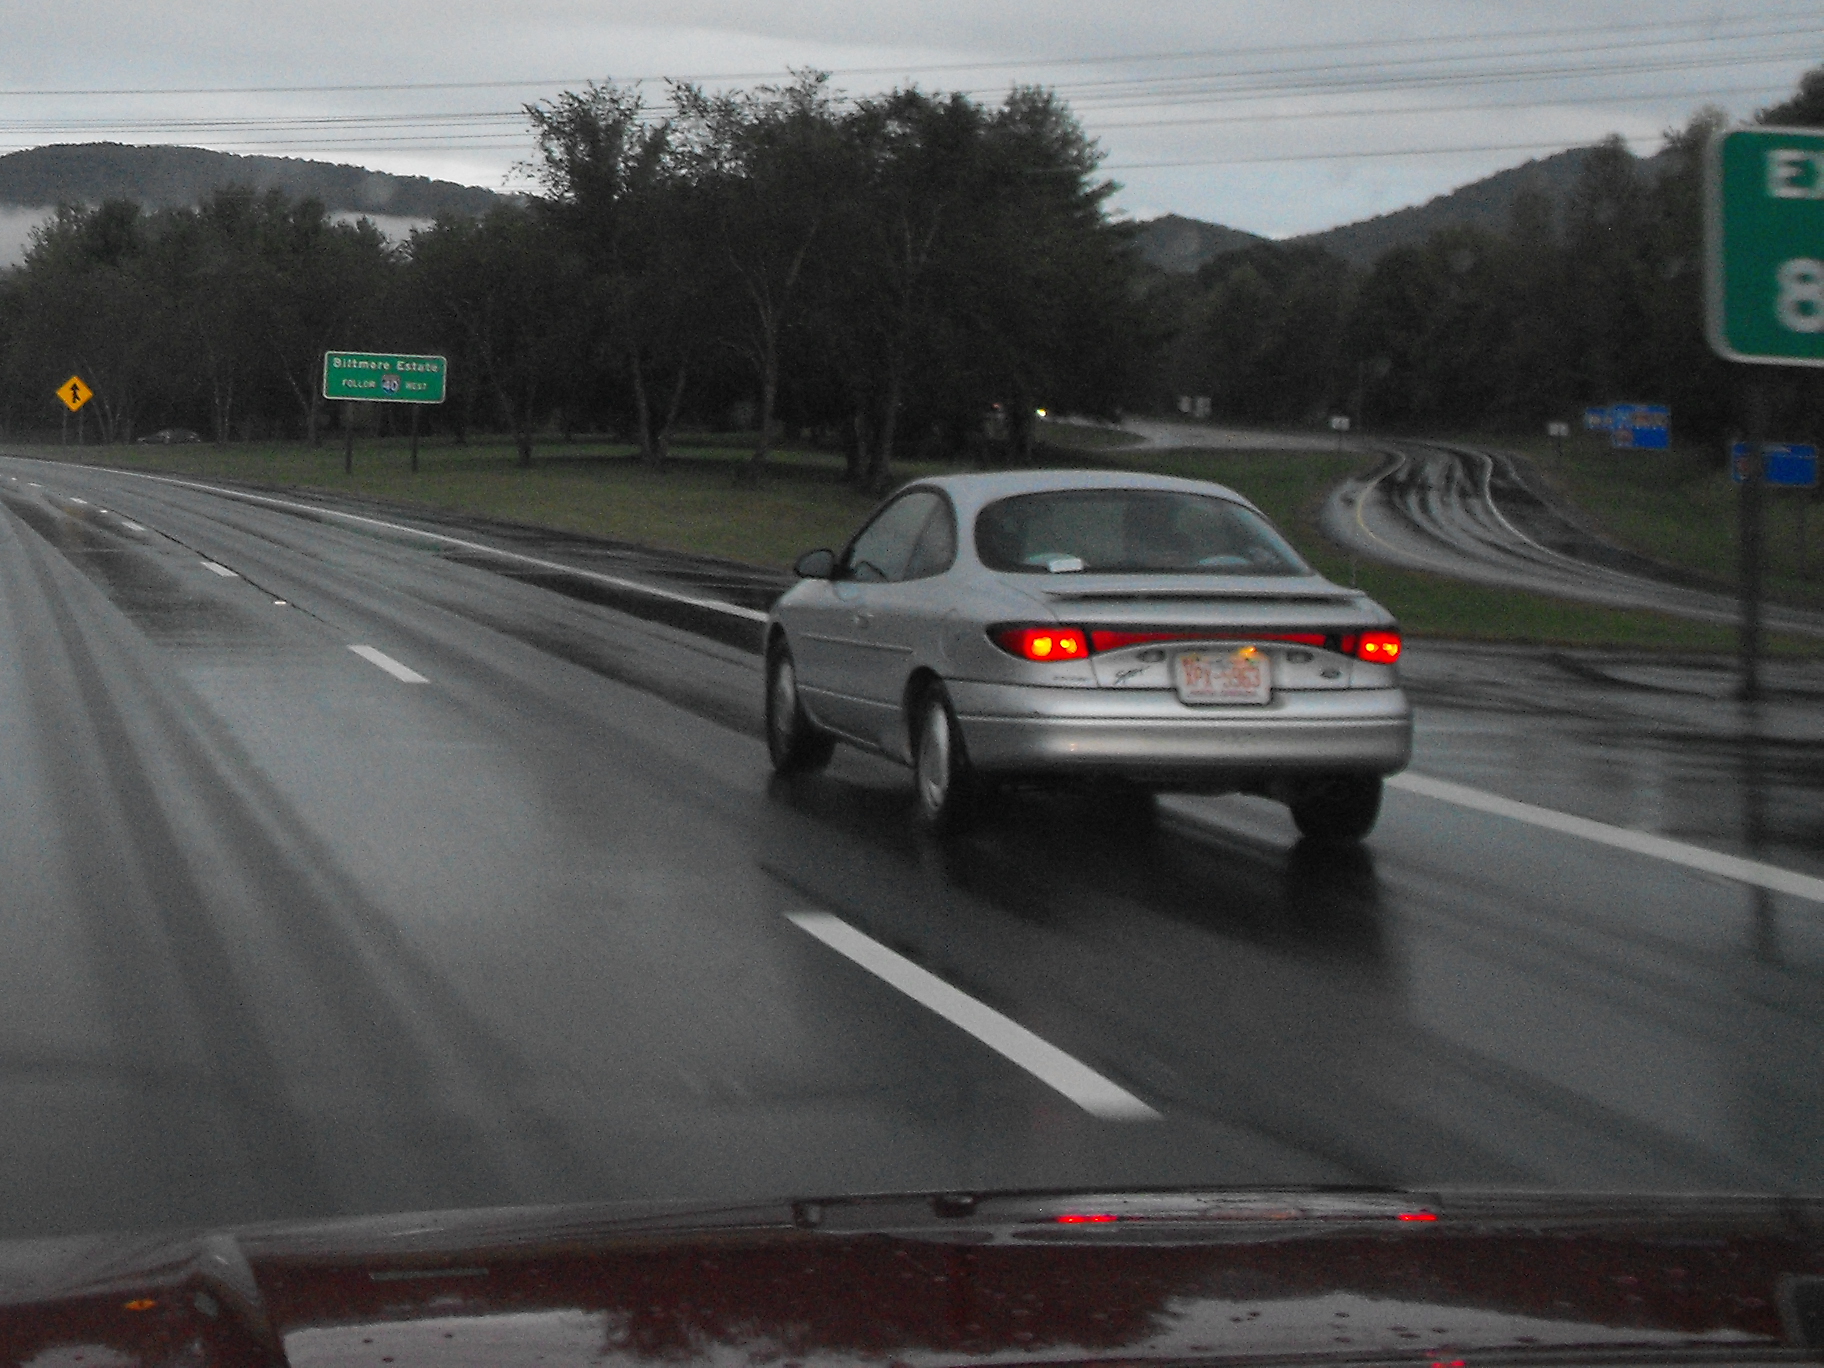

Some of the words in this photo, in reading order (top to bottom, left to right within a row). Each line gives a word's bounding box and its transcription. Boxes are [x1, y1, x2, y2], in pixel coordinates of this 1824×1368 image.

[333, 357, 391, 371] Biltmore
[396, 360, 439, 373] Estate
[341, 378, 377, 389] FOLLOW
[405, 381, 428, 391] WEST
